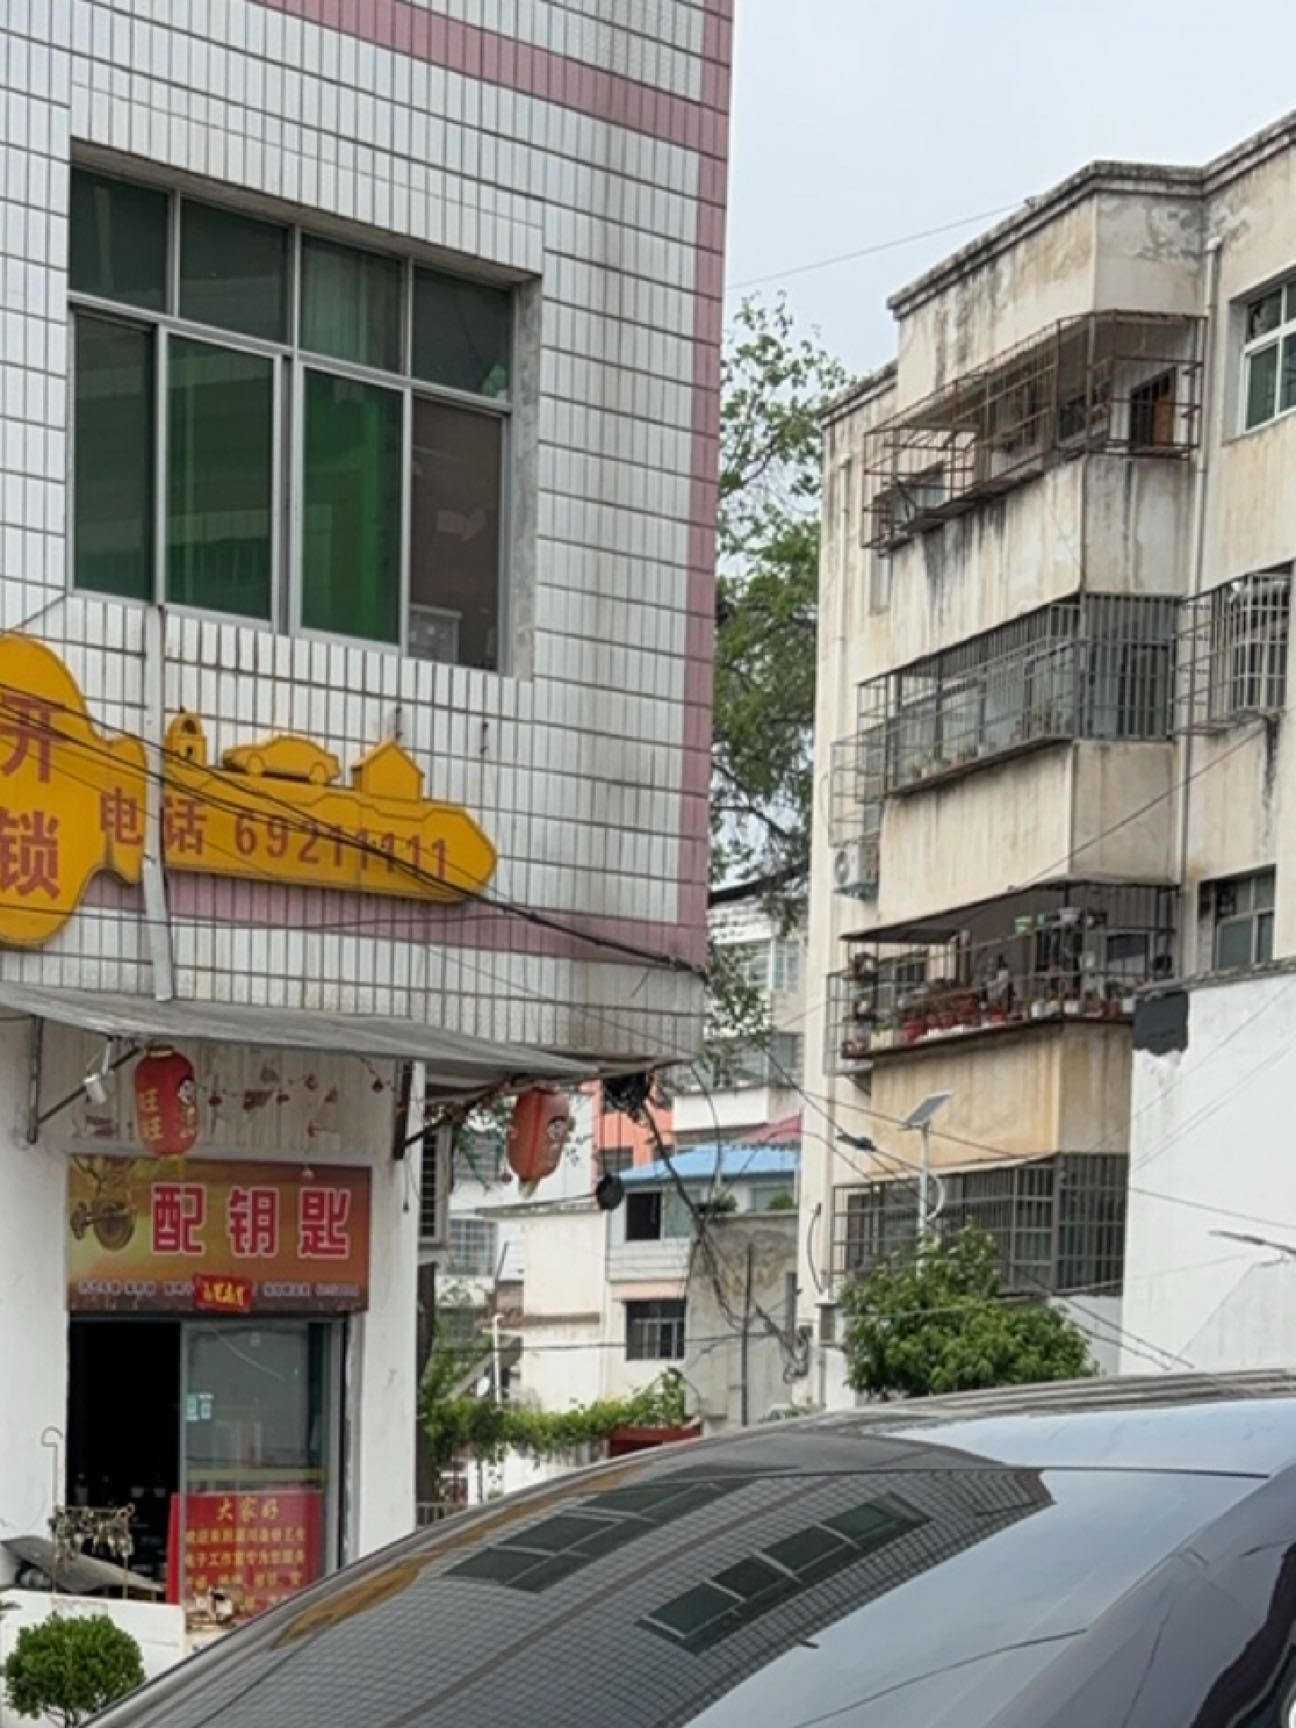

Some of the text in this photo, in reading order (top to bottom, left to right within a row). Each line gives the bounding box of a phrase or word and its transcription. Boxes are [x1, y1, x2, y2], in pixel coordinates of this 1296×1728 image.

[99, 786, 449, 882] 电话 69211111
[151, 1181, 351, 1260] 配钥匙
[217, 1496, 280, 1523] 大家好
